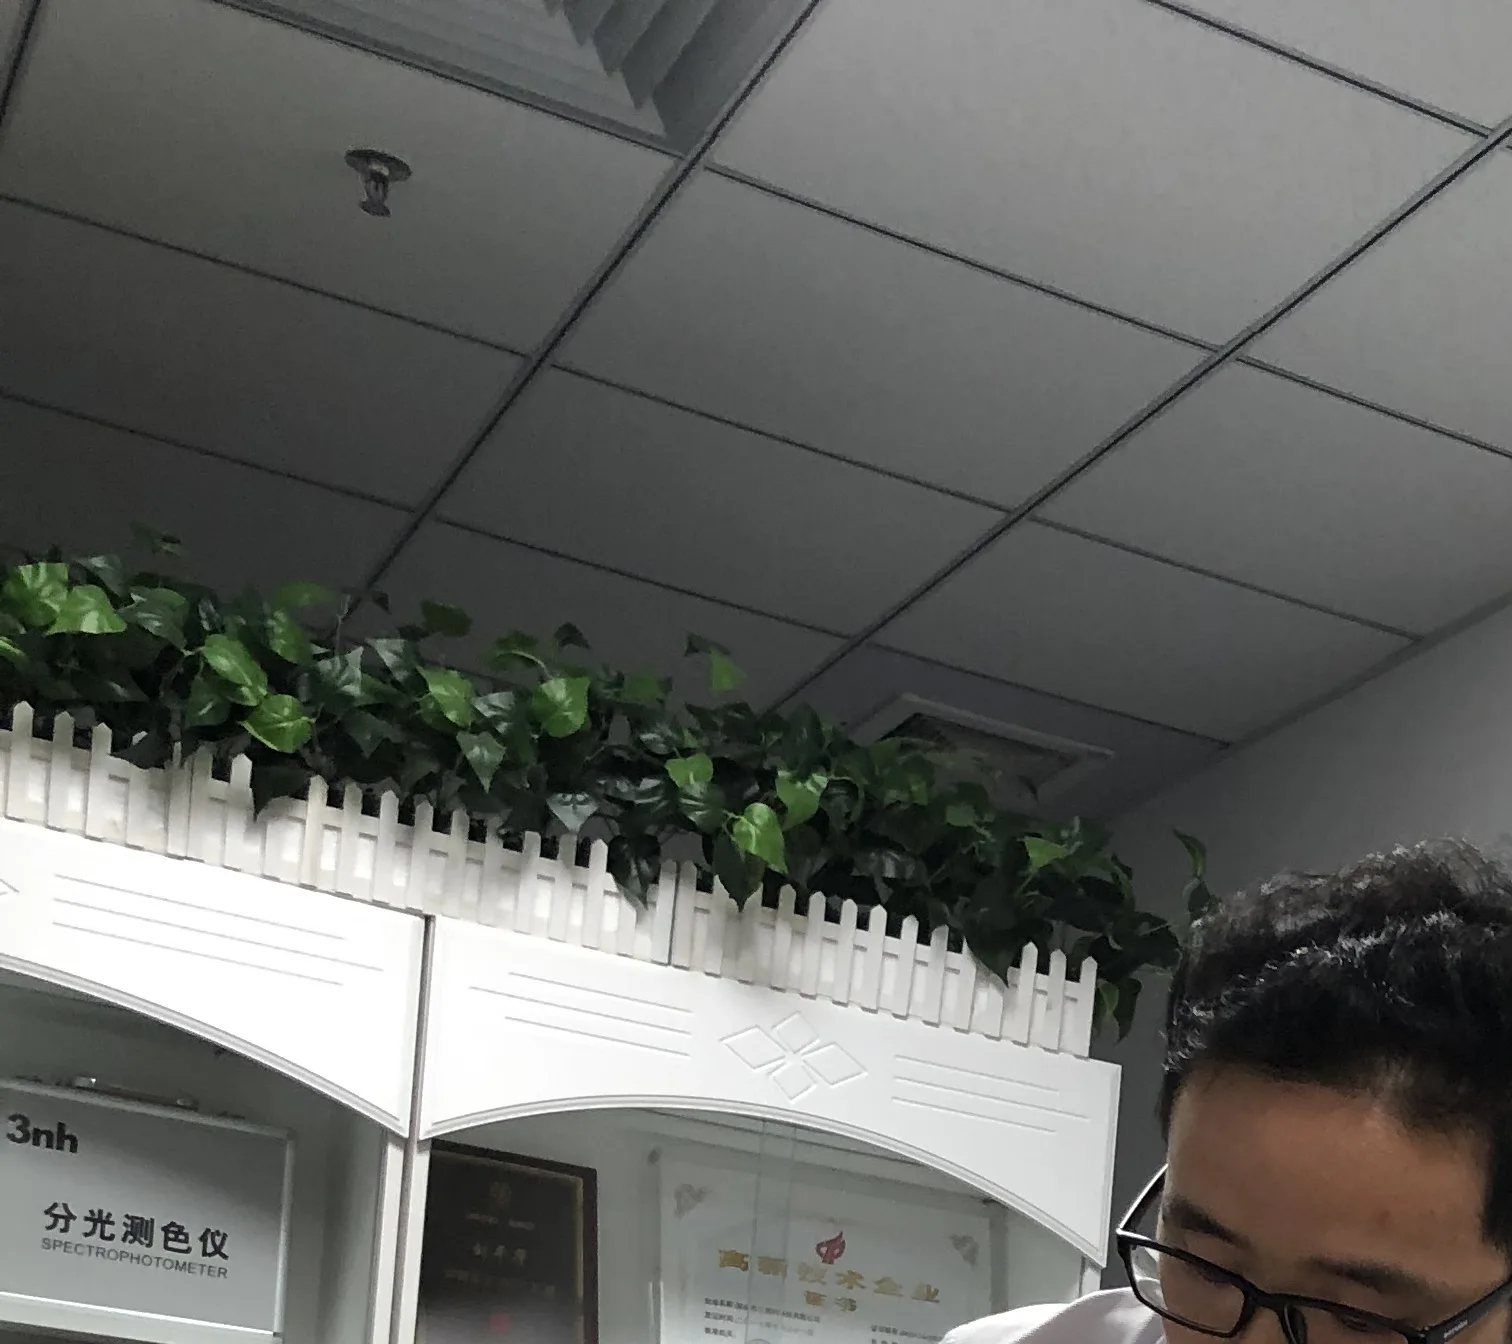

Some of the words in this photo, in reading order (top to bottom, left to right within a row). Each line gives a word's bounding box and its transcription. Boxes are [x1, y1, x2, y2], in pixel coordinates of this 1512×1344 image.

[6, 1113, 79, 1154] 3nh
[43, 1202, 229, 1260] 分光测色仪
[41, 1237, 228, 1279] SPECTROPHOTOMETER
